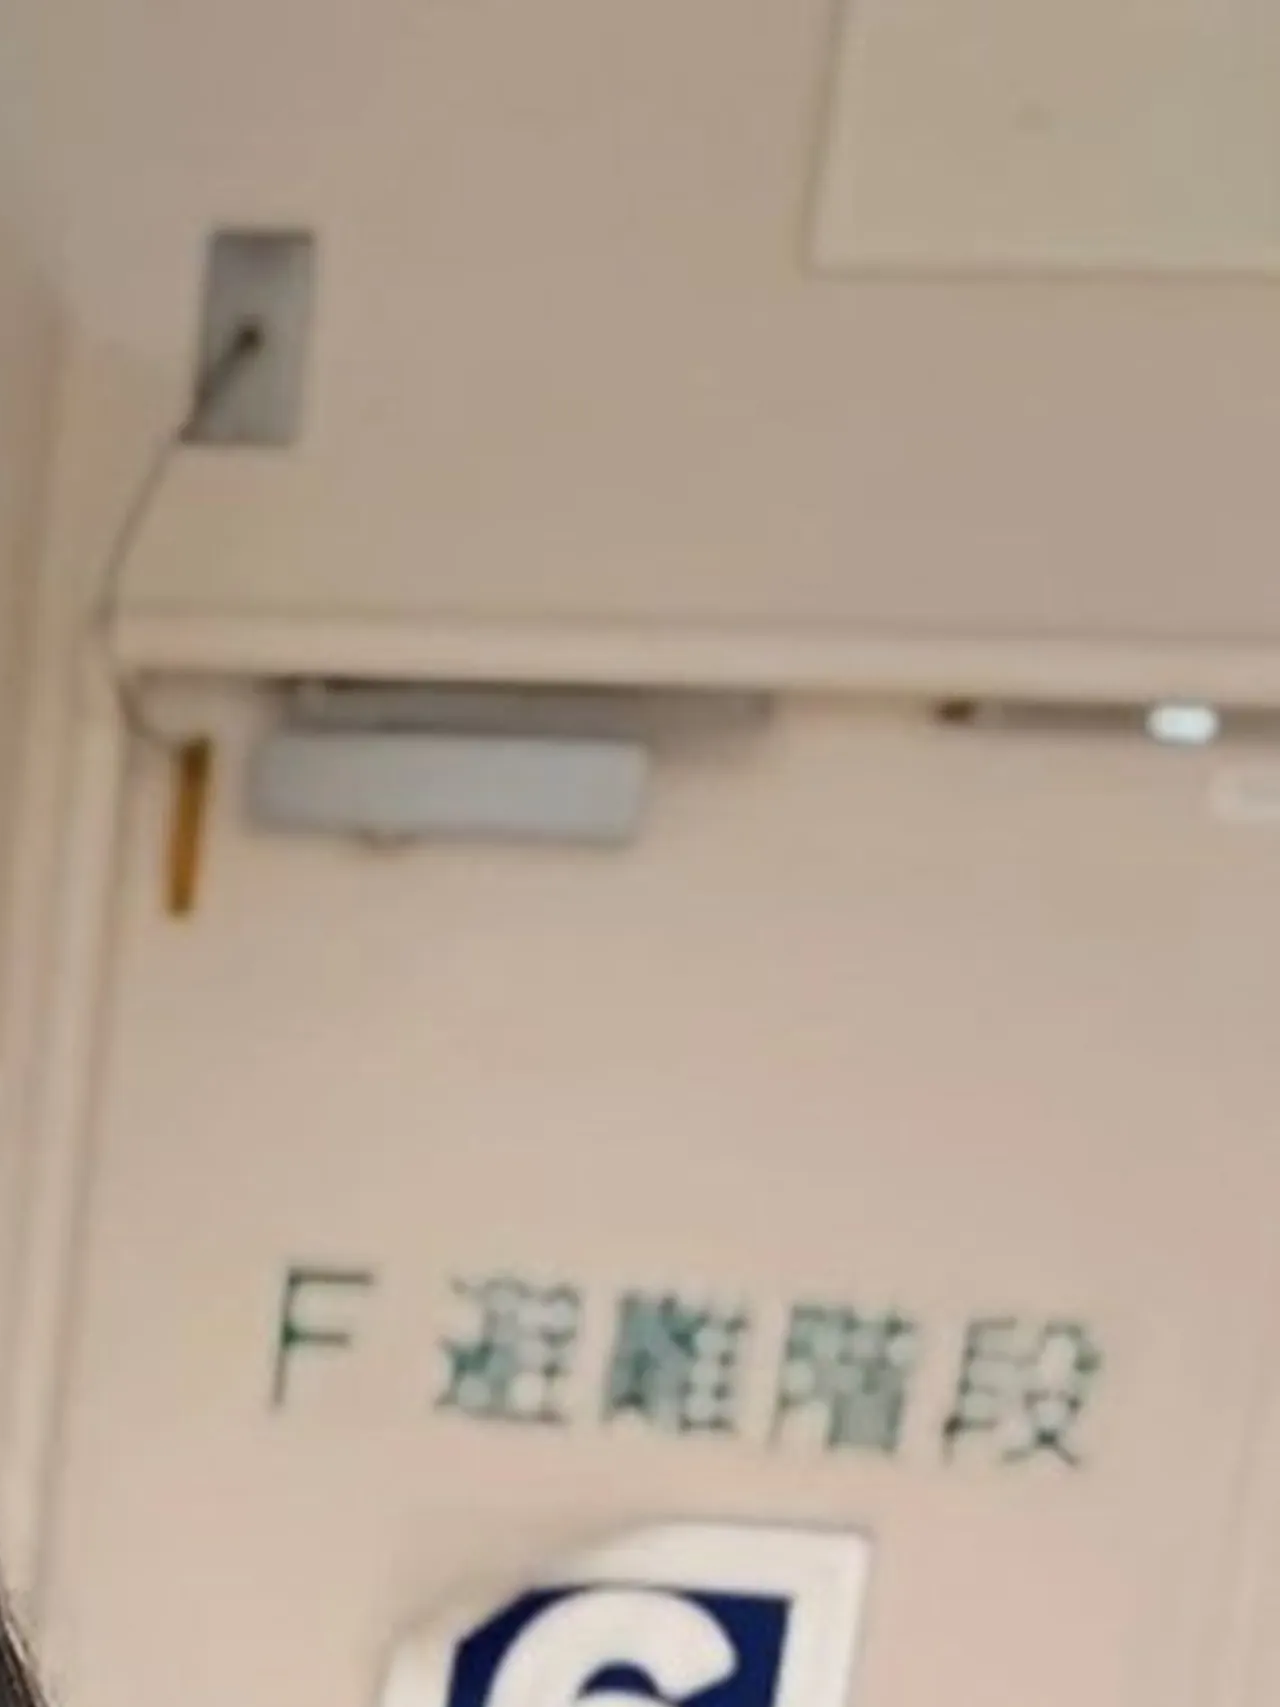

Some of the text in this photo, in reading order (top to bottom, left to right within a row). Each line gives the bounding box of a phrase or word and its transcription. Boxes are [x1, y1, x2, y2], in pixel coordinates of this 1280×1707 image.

[270, 1265, 1102, 1465] F 避難階段
